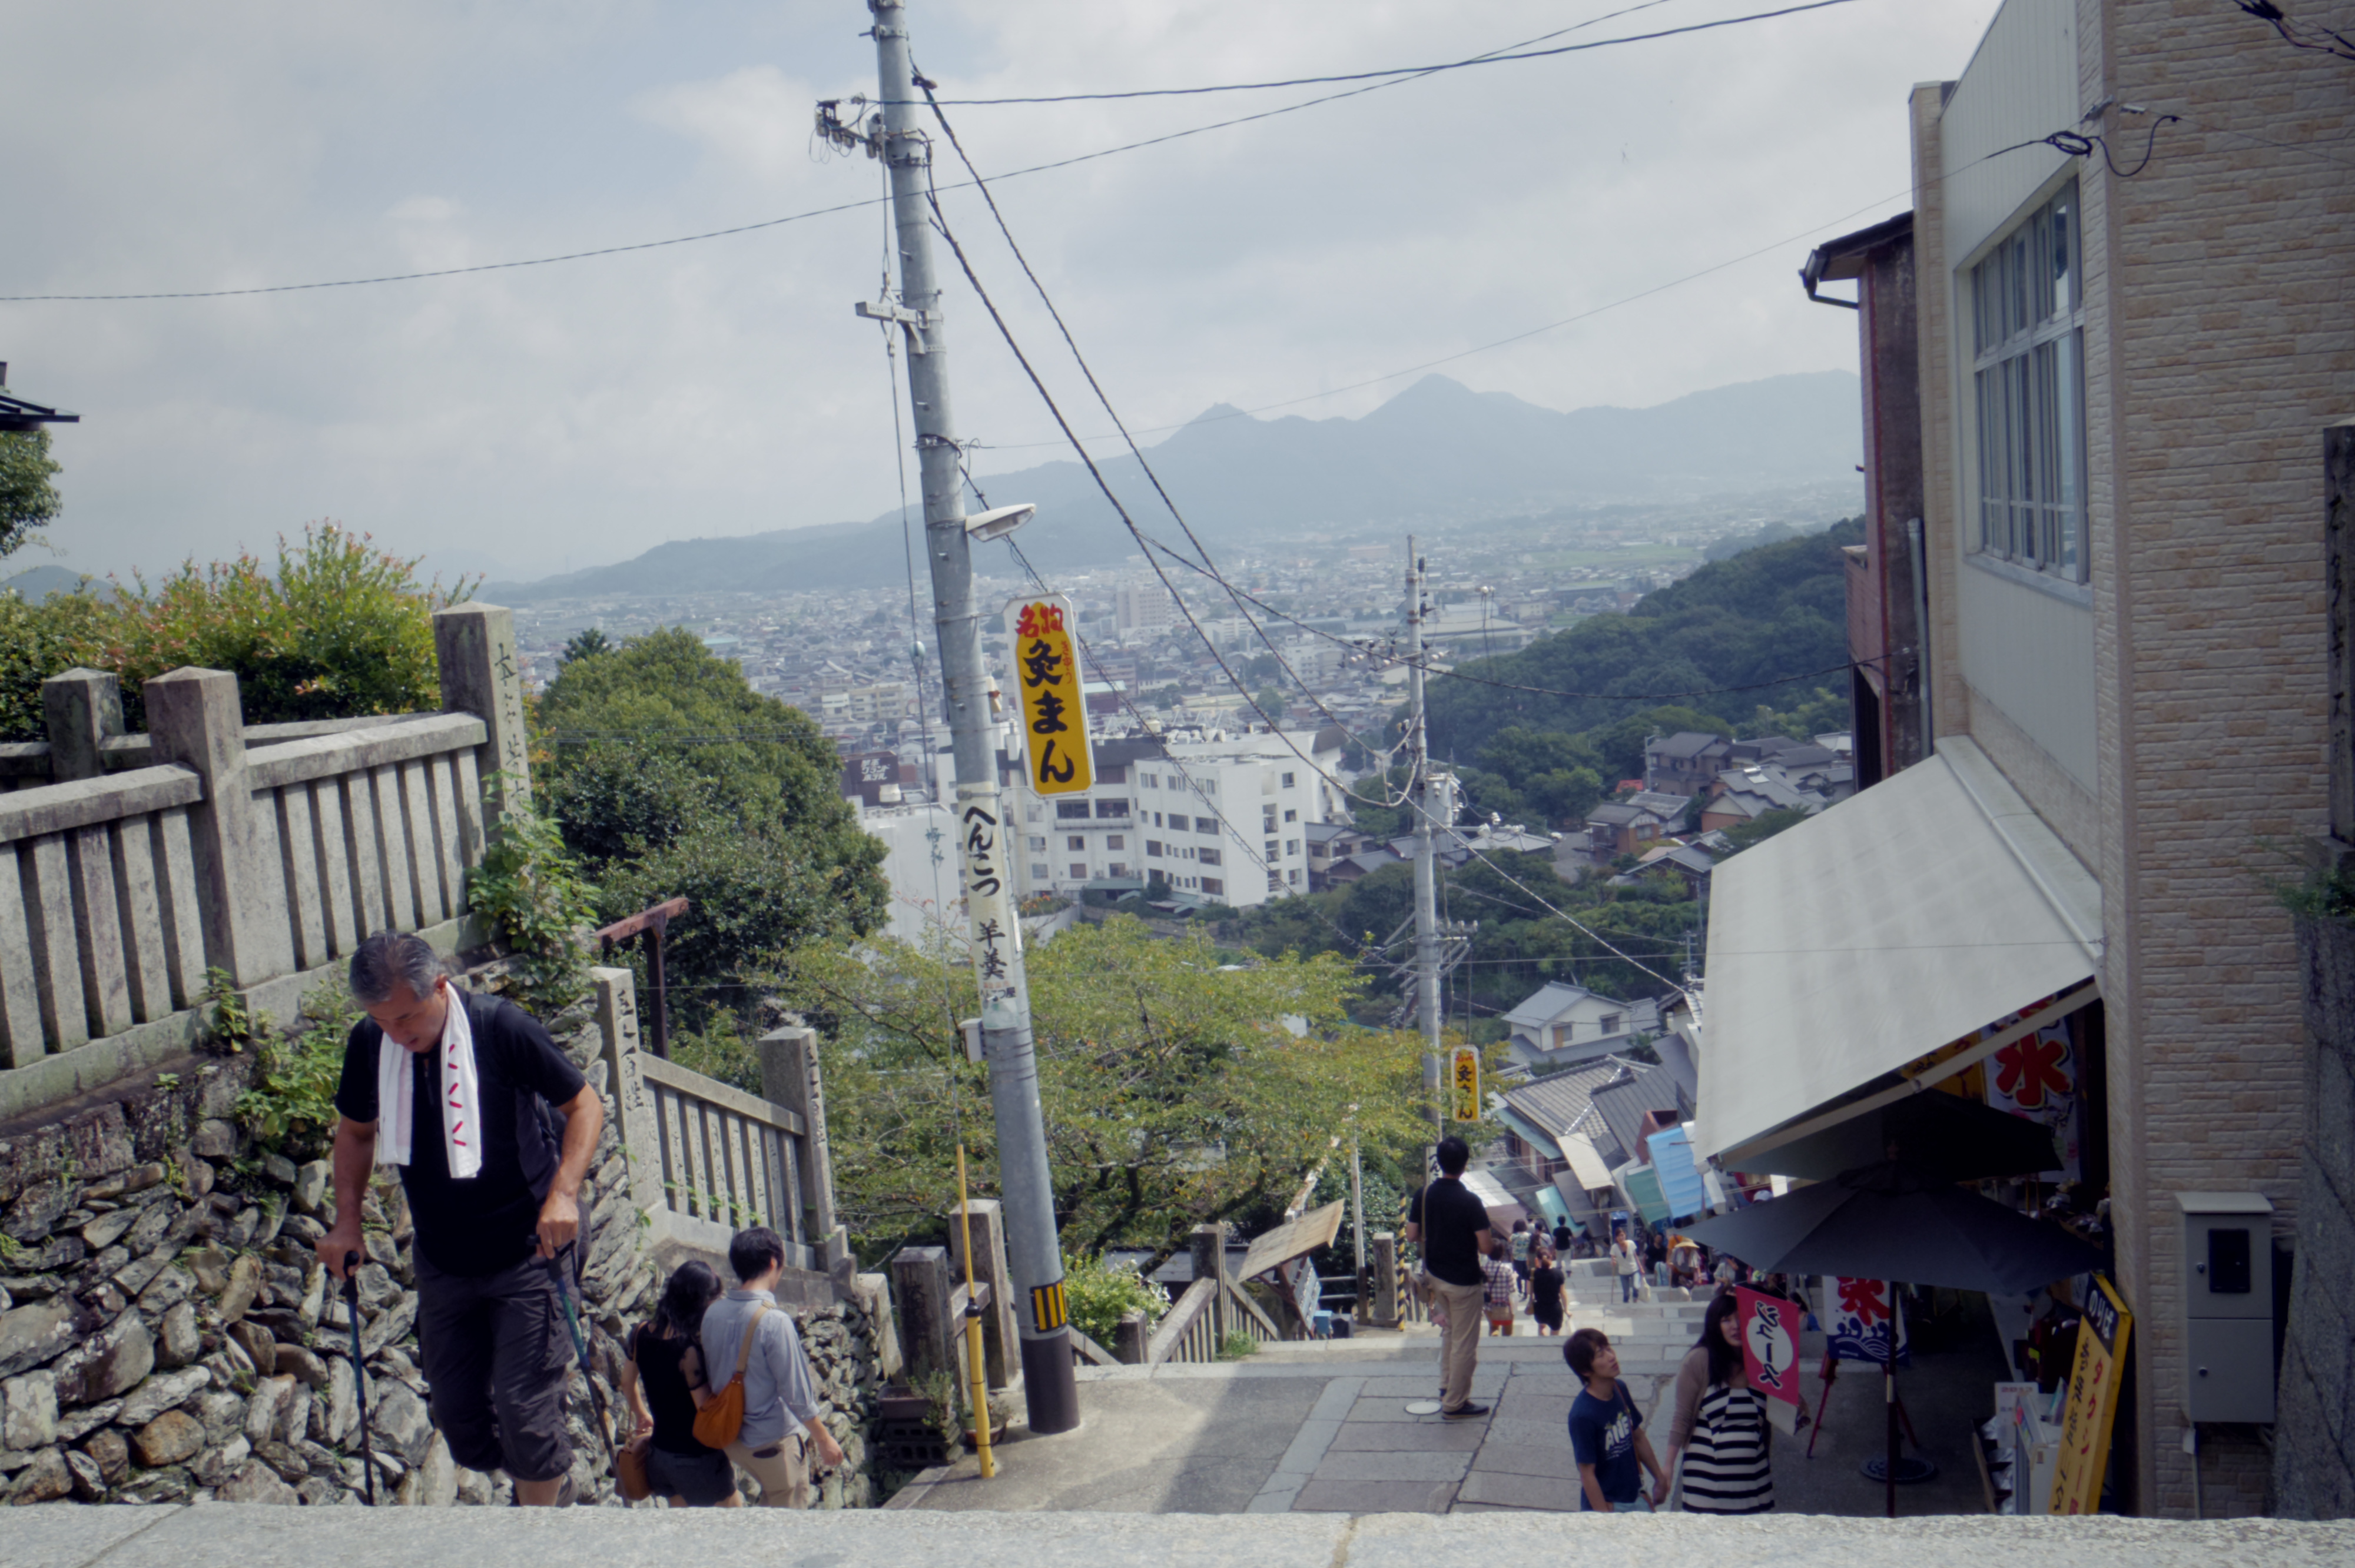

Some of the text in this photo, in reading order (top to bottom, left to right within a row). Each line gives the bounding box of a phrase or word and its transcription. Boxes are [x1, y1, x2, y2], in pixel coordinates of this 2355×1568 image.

[1015, 603, 1063, 638] 名物
[1023, 638, 1075, 783] 灸まん
[862, 772, 888, 782] ホテル
[963, 806, 1001, 898] へんこつ
[975, 918, 1007, 980] 羊羹
[2088, 1289, 2115, 1340] のりば
